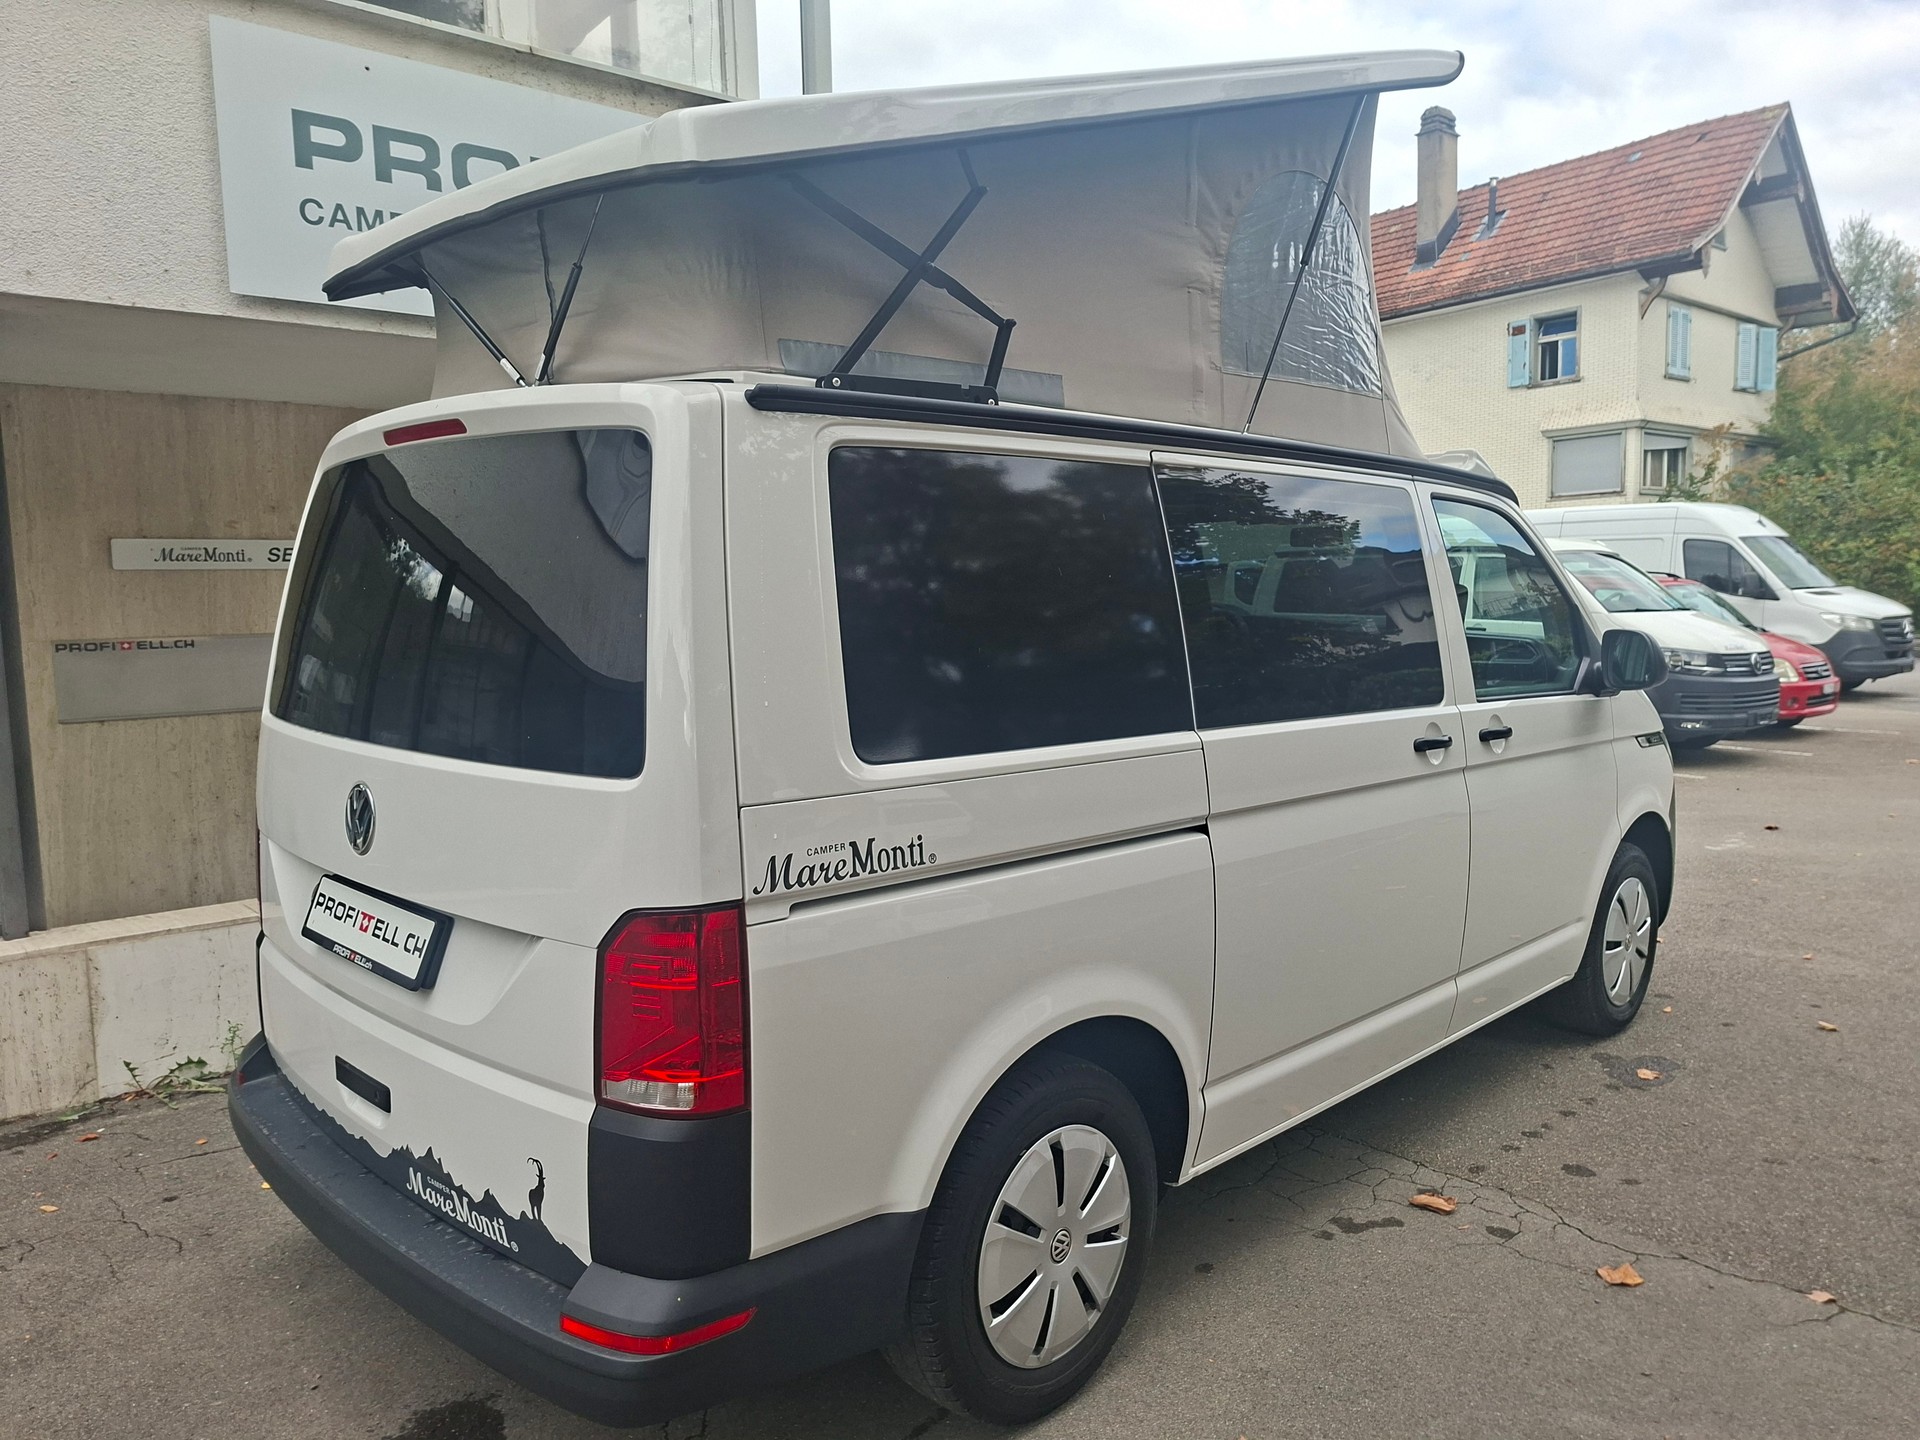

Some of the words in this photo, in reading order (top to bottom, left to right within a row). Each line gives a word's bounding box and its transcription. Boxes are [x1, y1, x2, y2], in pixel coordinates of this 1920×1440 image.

[291, 108, 541, 192] PRO
[299, 198, 402, 232] CAM
[806, 842, 846, 857] CAMPER
